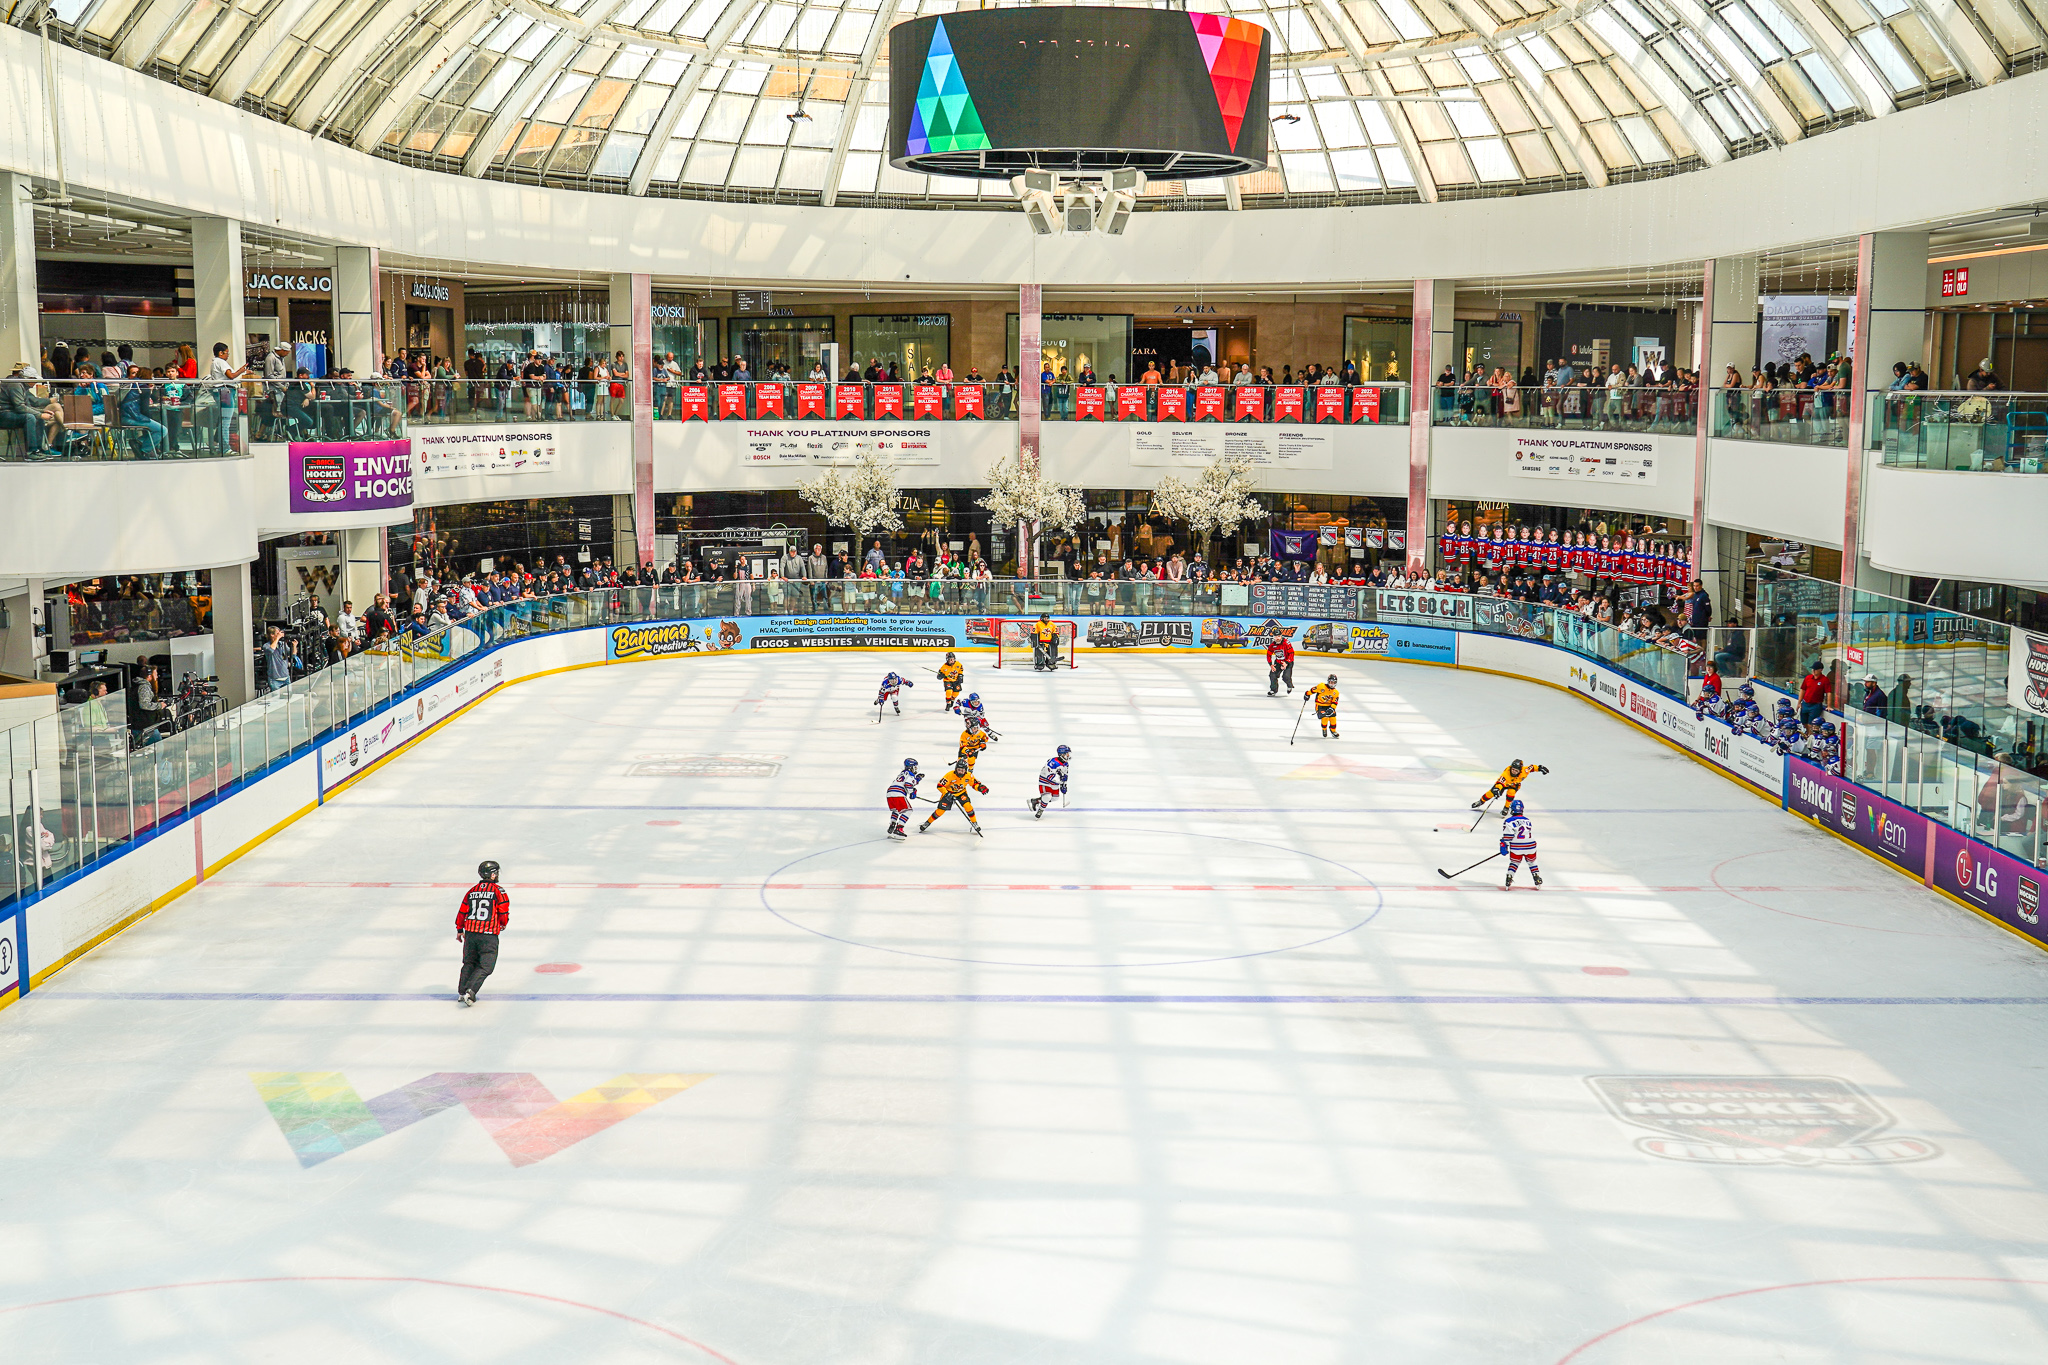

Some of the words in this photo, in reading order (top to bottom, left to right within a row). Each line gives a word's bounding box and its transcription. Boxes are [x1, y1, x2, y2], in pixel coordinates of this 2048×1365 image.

[1958, 272, 1967, 281] UNI
[249, 274, 332, 292] JACK&JO
[1957, 282, 1967, 293] QLO
[651, 306, 686, 318] ROVSKI
[1174, 305, 1216, 314] ZARA
[1767, 305, 1823, 315] DIAMONDS
[422, 436, 445, 445] THANK
[447, 436, 461, 444] YOU
[462, 435, 504, 443] PLATINUM
[506, 433, 553, 441] SPONSORS
[1518, 439, 1549, 447] THANK
[1570, 441, 1612, 450] PLATINUM
[1614, 443, 1653, 452] SPONSORS
[1378, 594, 1415, 612] LETS
[1418, 597, 1437, 614] GO
[1440, 598, 1470, 618] CJR!
[794, 618, 818, 626] Design
[1494, 615, 1504, 623] GO
[1142, 622, 1192, 637] ELITE
[1249, 627, 1262, 636] FAIR
[1352, 627, 1382, 638] Duck
[614, 625, 688, 650] Bananas
[756, 640, 790, 648] LOGOS
[801, 638, 853, 647] WEBSITES
[864, 637, 909, 646] VEHICLE
[912, 638, 950, 647] WRAPS
[1353, 638, 1388, 650] Duct
[1412, 642, 1451, 651] bananascreative
[1848, 649, 1863, 662] HOME
[1600, 681, 1617, 698] SAMSUNG
[1662, 711, 1677, 729] CVG
[1705, 727, 1729, 760] flexiti
[1792, 773, 1801, 788] The
[1801, 776, 1834, 814] BRICK
[1976, 862, 1998, 897] LG
[469, 892, 495, 900] STEWART
[468, 900, 490, 921] 16
[1620, 1101, 1860, 1116] HOCKEY
